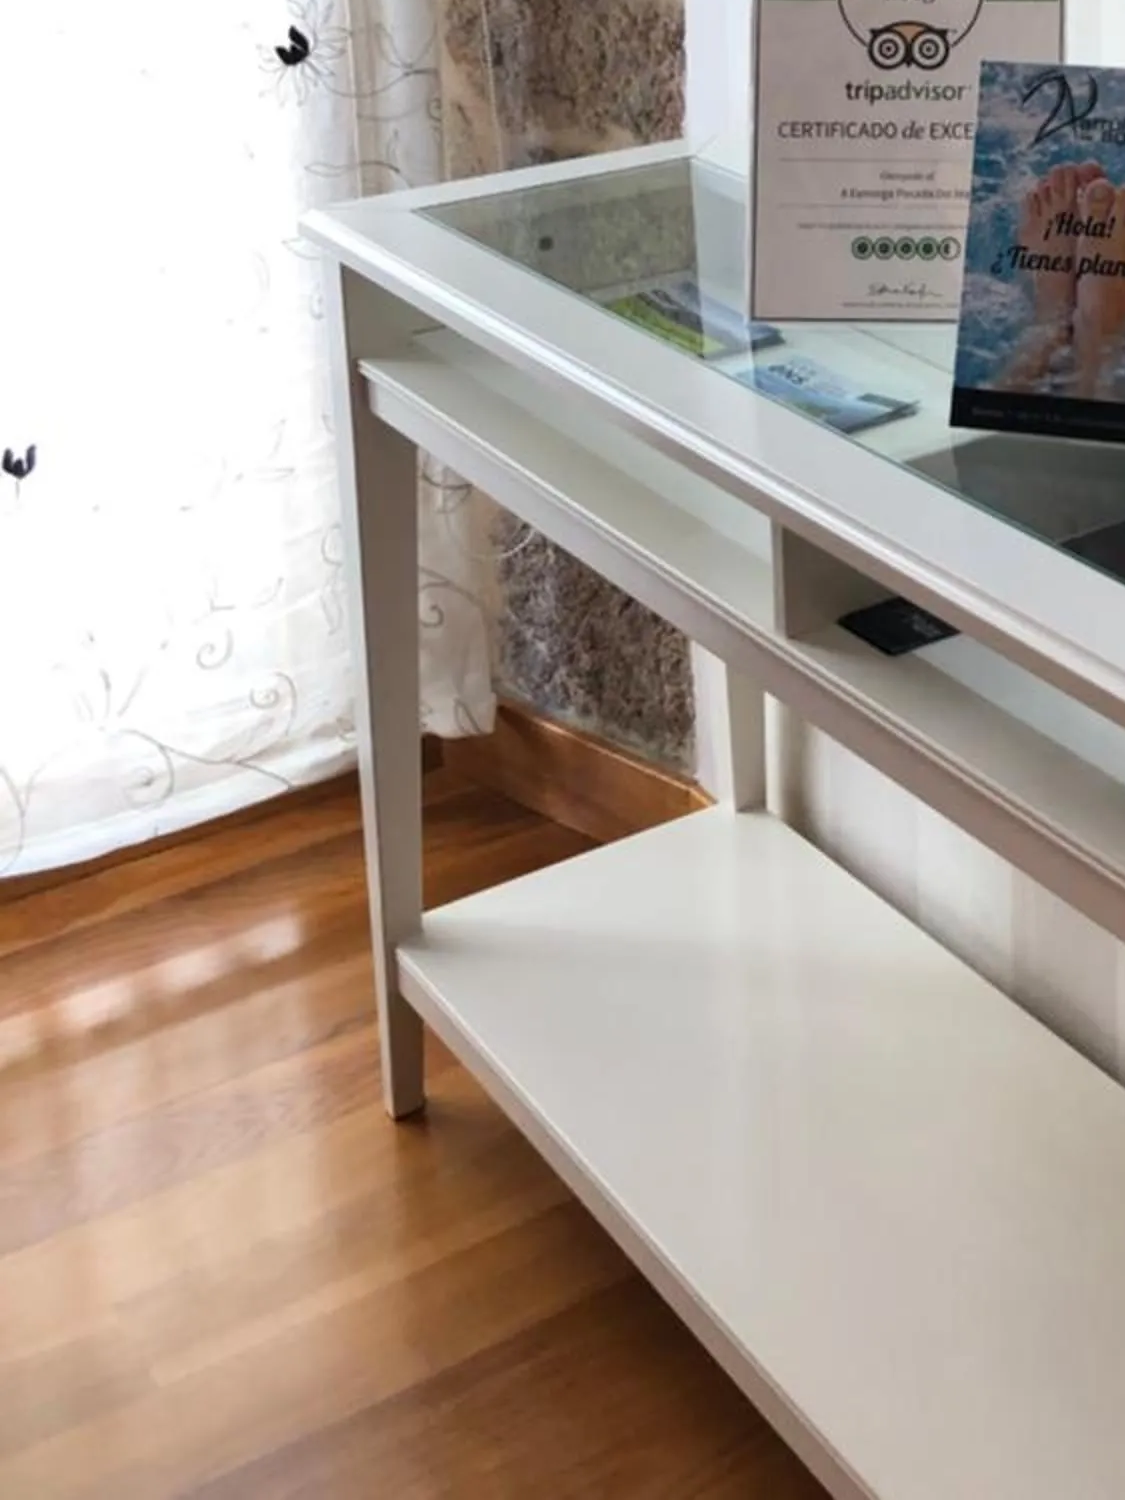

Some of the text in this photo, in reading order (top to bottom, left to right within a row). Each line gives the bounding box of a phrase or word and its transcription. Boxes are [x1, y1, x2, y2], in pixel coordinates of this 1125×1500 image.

[845, 81, 966, 106] tripadvisor
[777, 121, 898, 141] CERTIFICADO
[901, 121, 926, 141] de
[1043, 211, 1116, 241] ¡Hola!
[990, 245, 1074, 276] ¿Tienes
